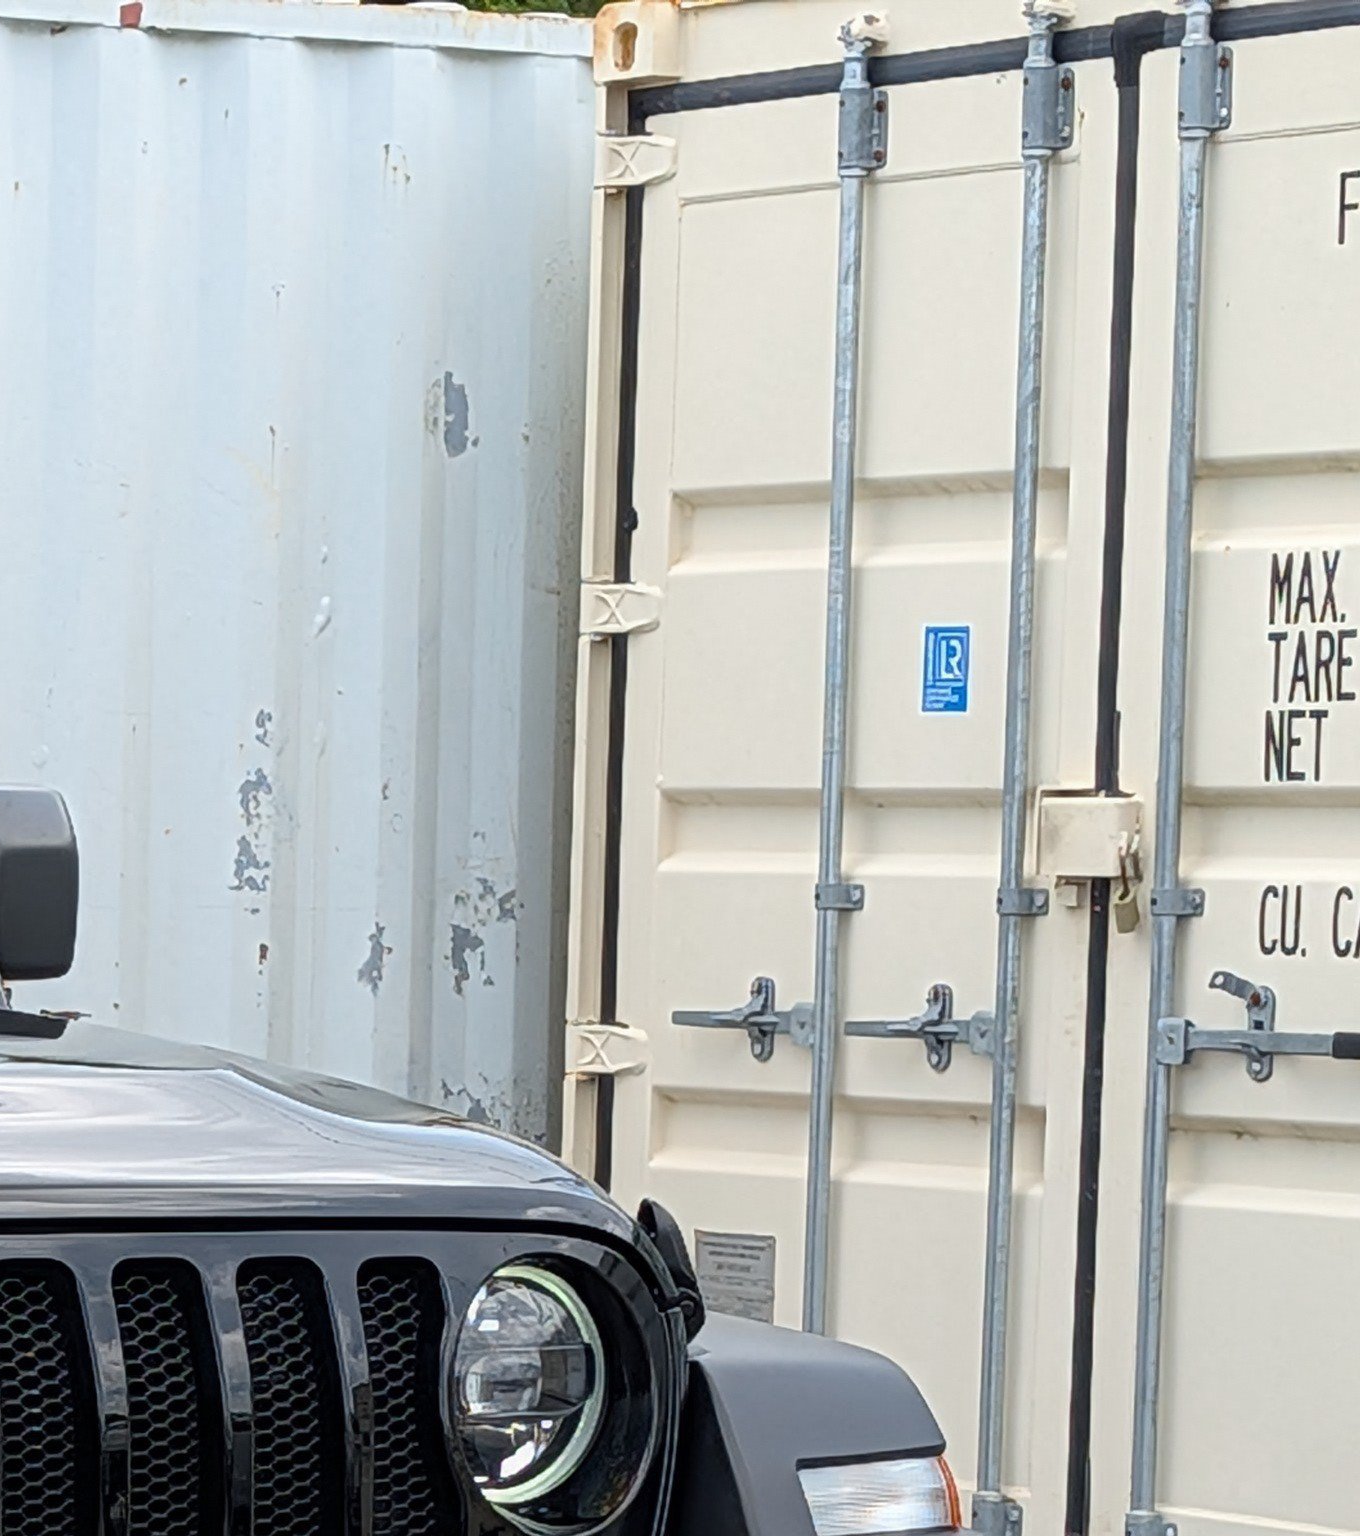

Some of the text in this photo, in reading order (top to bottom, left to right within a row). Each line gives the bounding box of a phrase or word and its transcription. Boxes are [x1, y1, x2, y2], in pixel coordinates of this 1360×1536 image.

[1269, 551, 1347, 625] MAX.
[1268, 629, 1358, 703] TARE
[1265, 710, 1328, 782] NET
[1259, 884, 1306, 957] CU.
